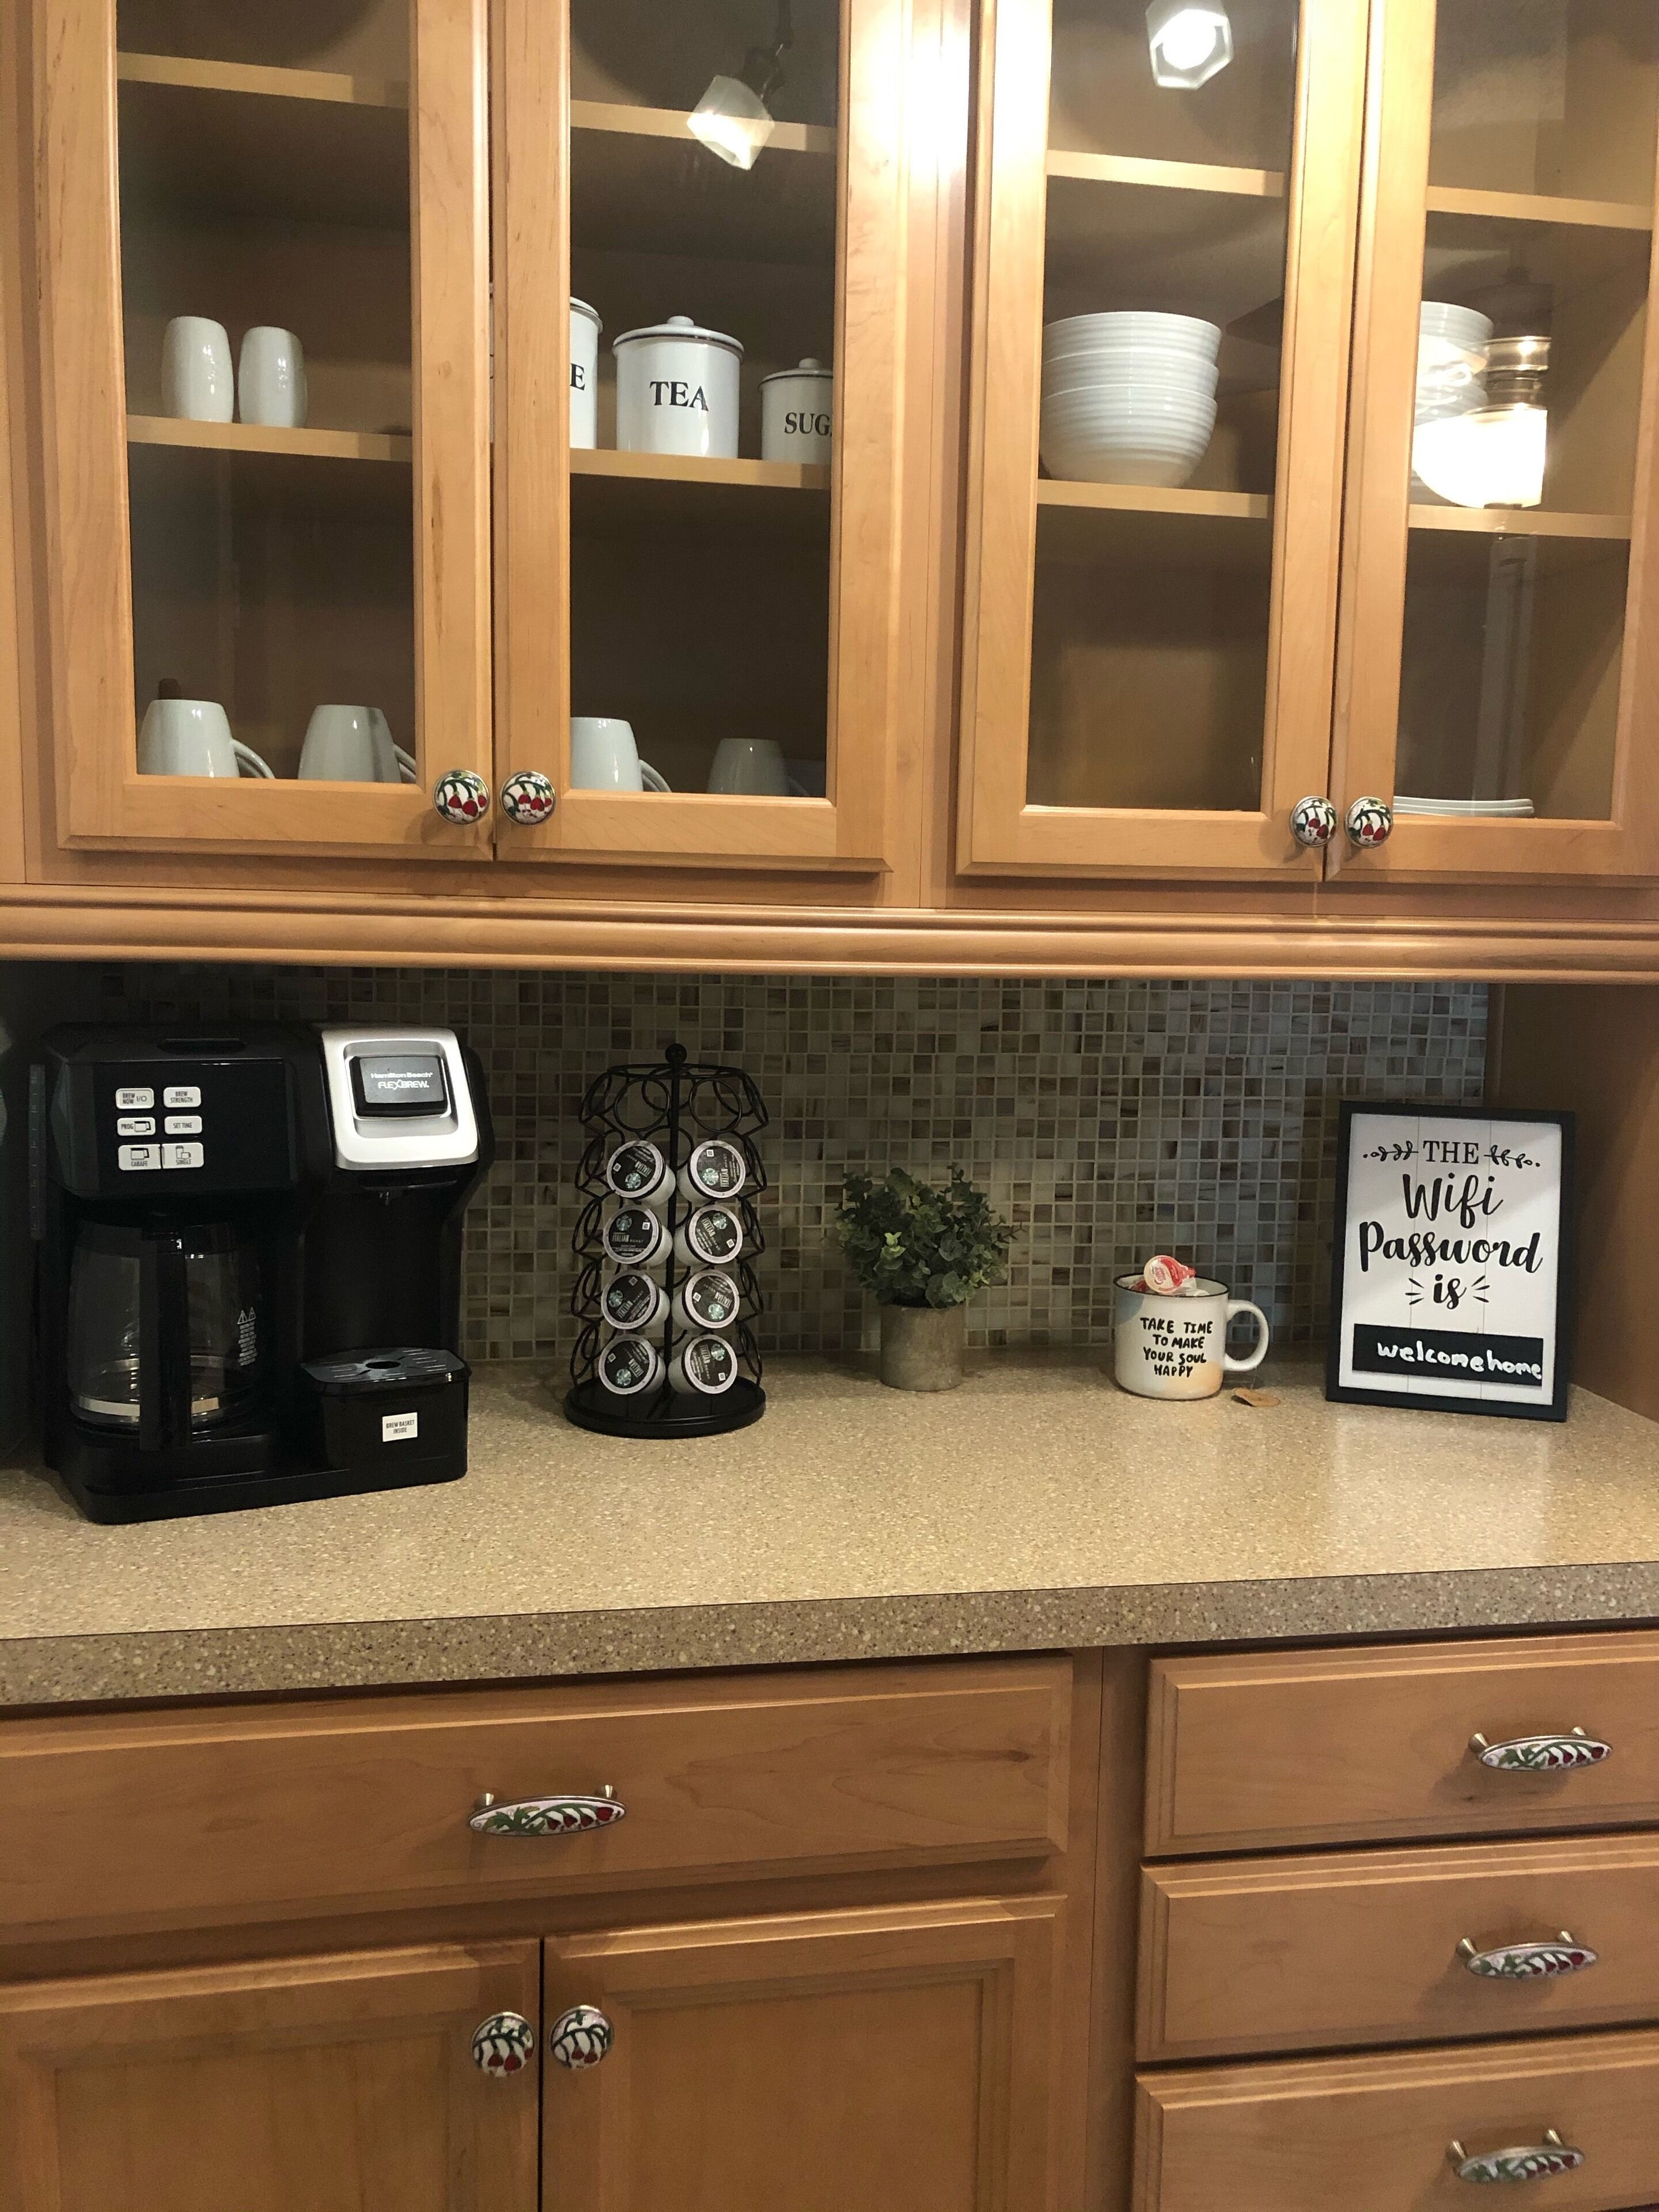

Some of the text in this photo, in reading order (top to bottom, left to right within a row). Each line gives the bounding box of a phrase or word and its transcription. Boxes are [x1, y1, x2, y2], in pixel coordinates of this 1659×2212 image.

[650, 381, 709, 411] TEA
[784, 412, 832, 437] SUG
[1422, 1140, 1479, 1164] THE
[1402, 1172, 1503, 1229] Wifi
[1359, 1221, 1543, 1274] Password
[1433, 1274, 1467, 1310] is
[617, 1300, 633, 1319] ITALIAN
[1140, 1317, 1213, 1334] TAKE TIME
[1152, 1334, 1205, 1349] TO MAKE
[1143, 1346, 1207, 1365] YOUR SOUL
[1377, 1340, 1542, 1380] welcomehome
[1153, 1364, 1194, 1377] HAPPY
